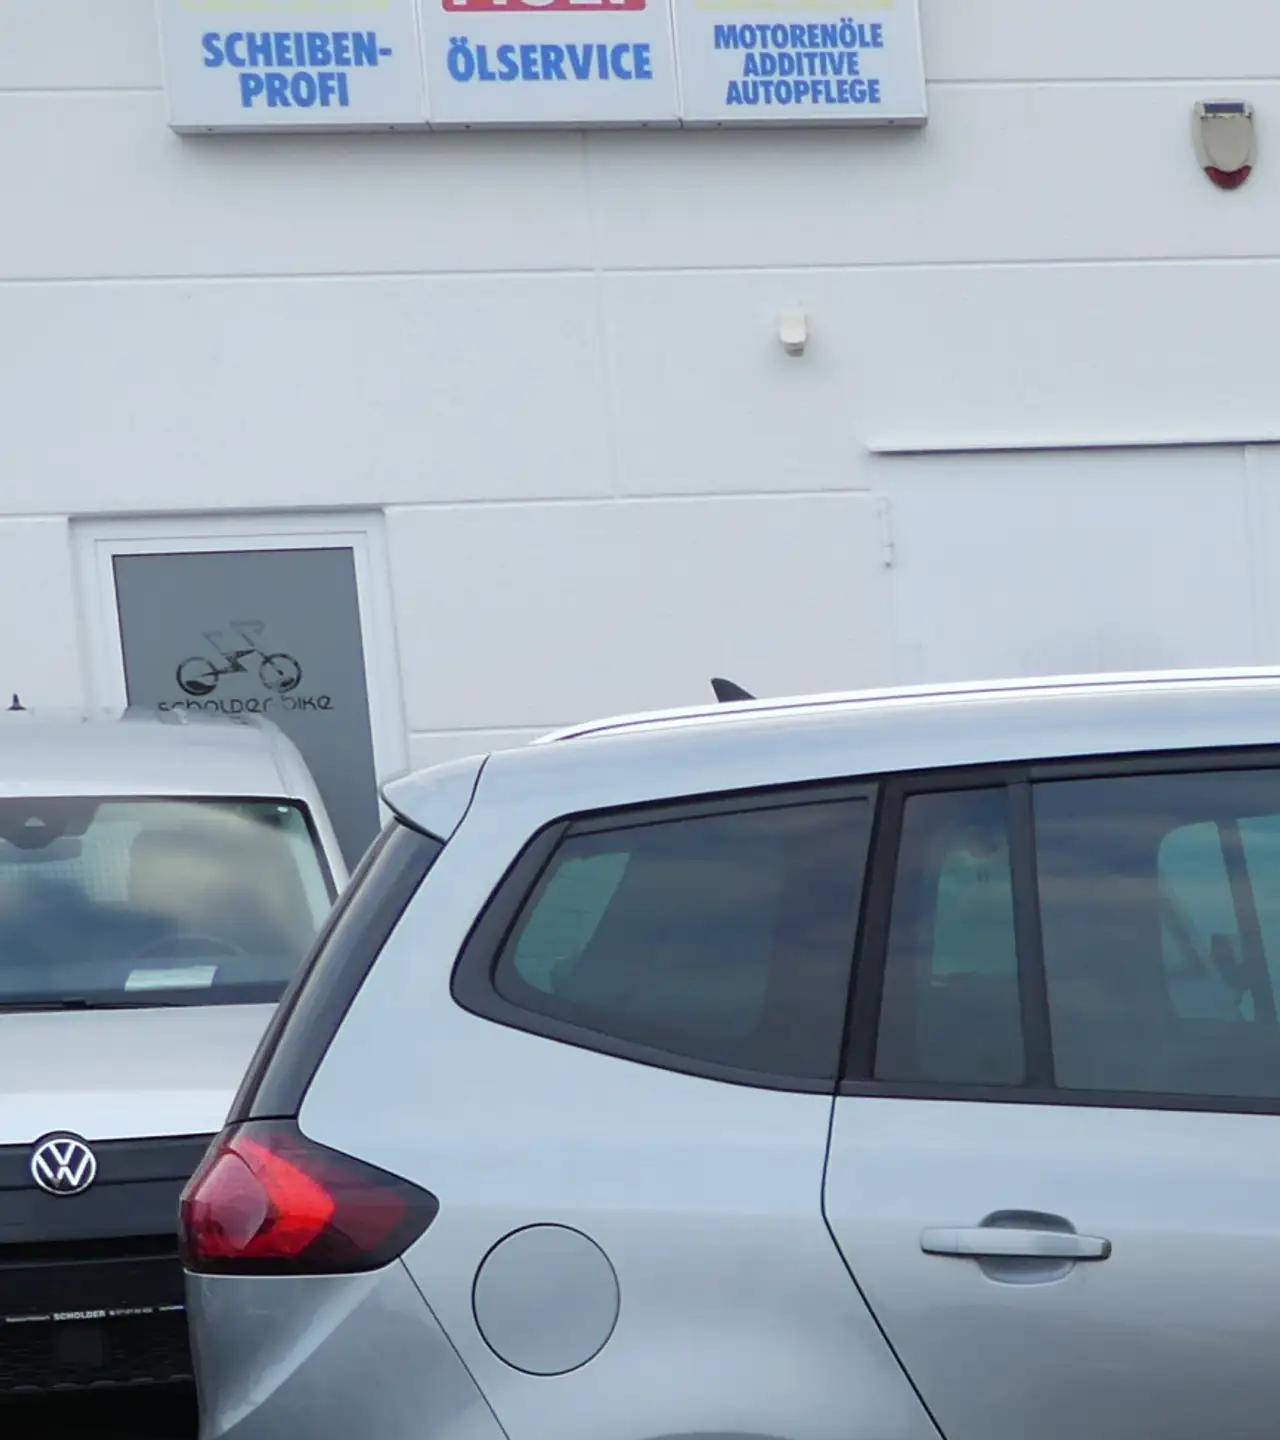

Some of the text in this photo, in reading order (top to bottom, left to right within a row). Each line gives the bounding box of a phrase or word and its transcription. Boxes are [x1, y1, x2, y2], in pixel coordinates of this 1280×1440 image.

[201, 31, 393, 68] SCHEIBEN-
[714, 17, 884, 49] MOTORENÖLE
[447, 36, 653, 82] ÖLSERVICE
[743, 52, 860, 77] ADDITIVE
[239, 72, 350, 107] PROFI
[726, 79, 881, 105] AUTOPFLEGE
[32, 1139, 96, 1194] VW
